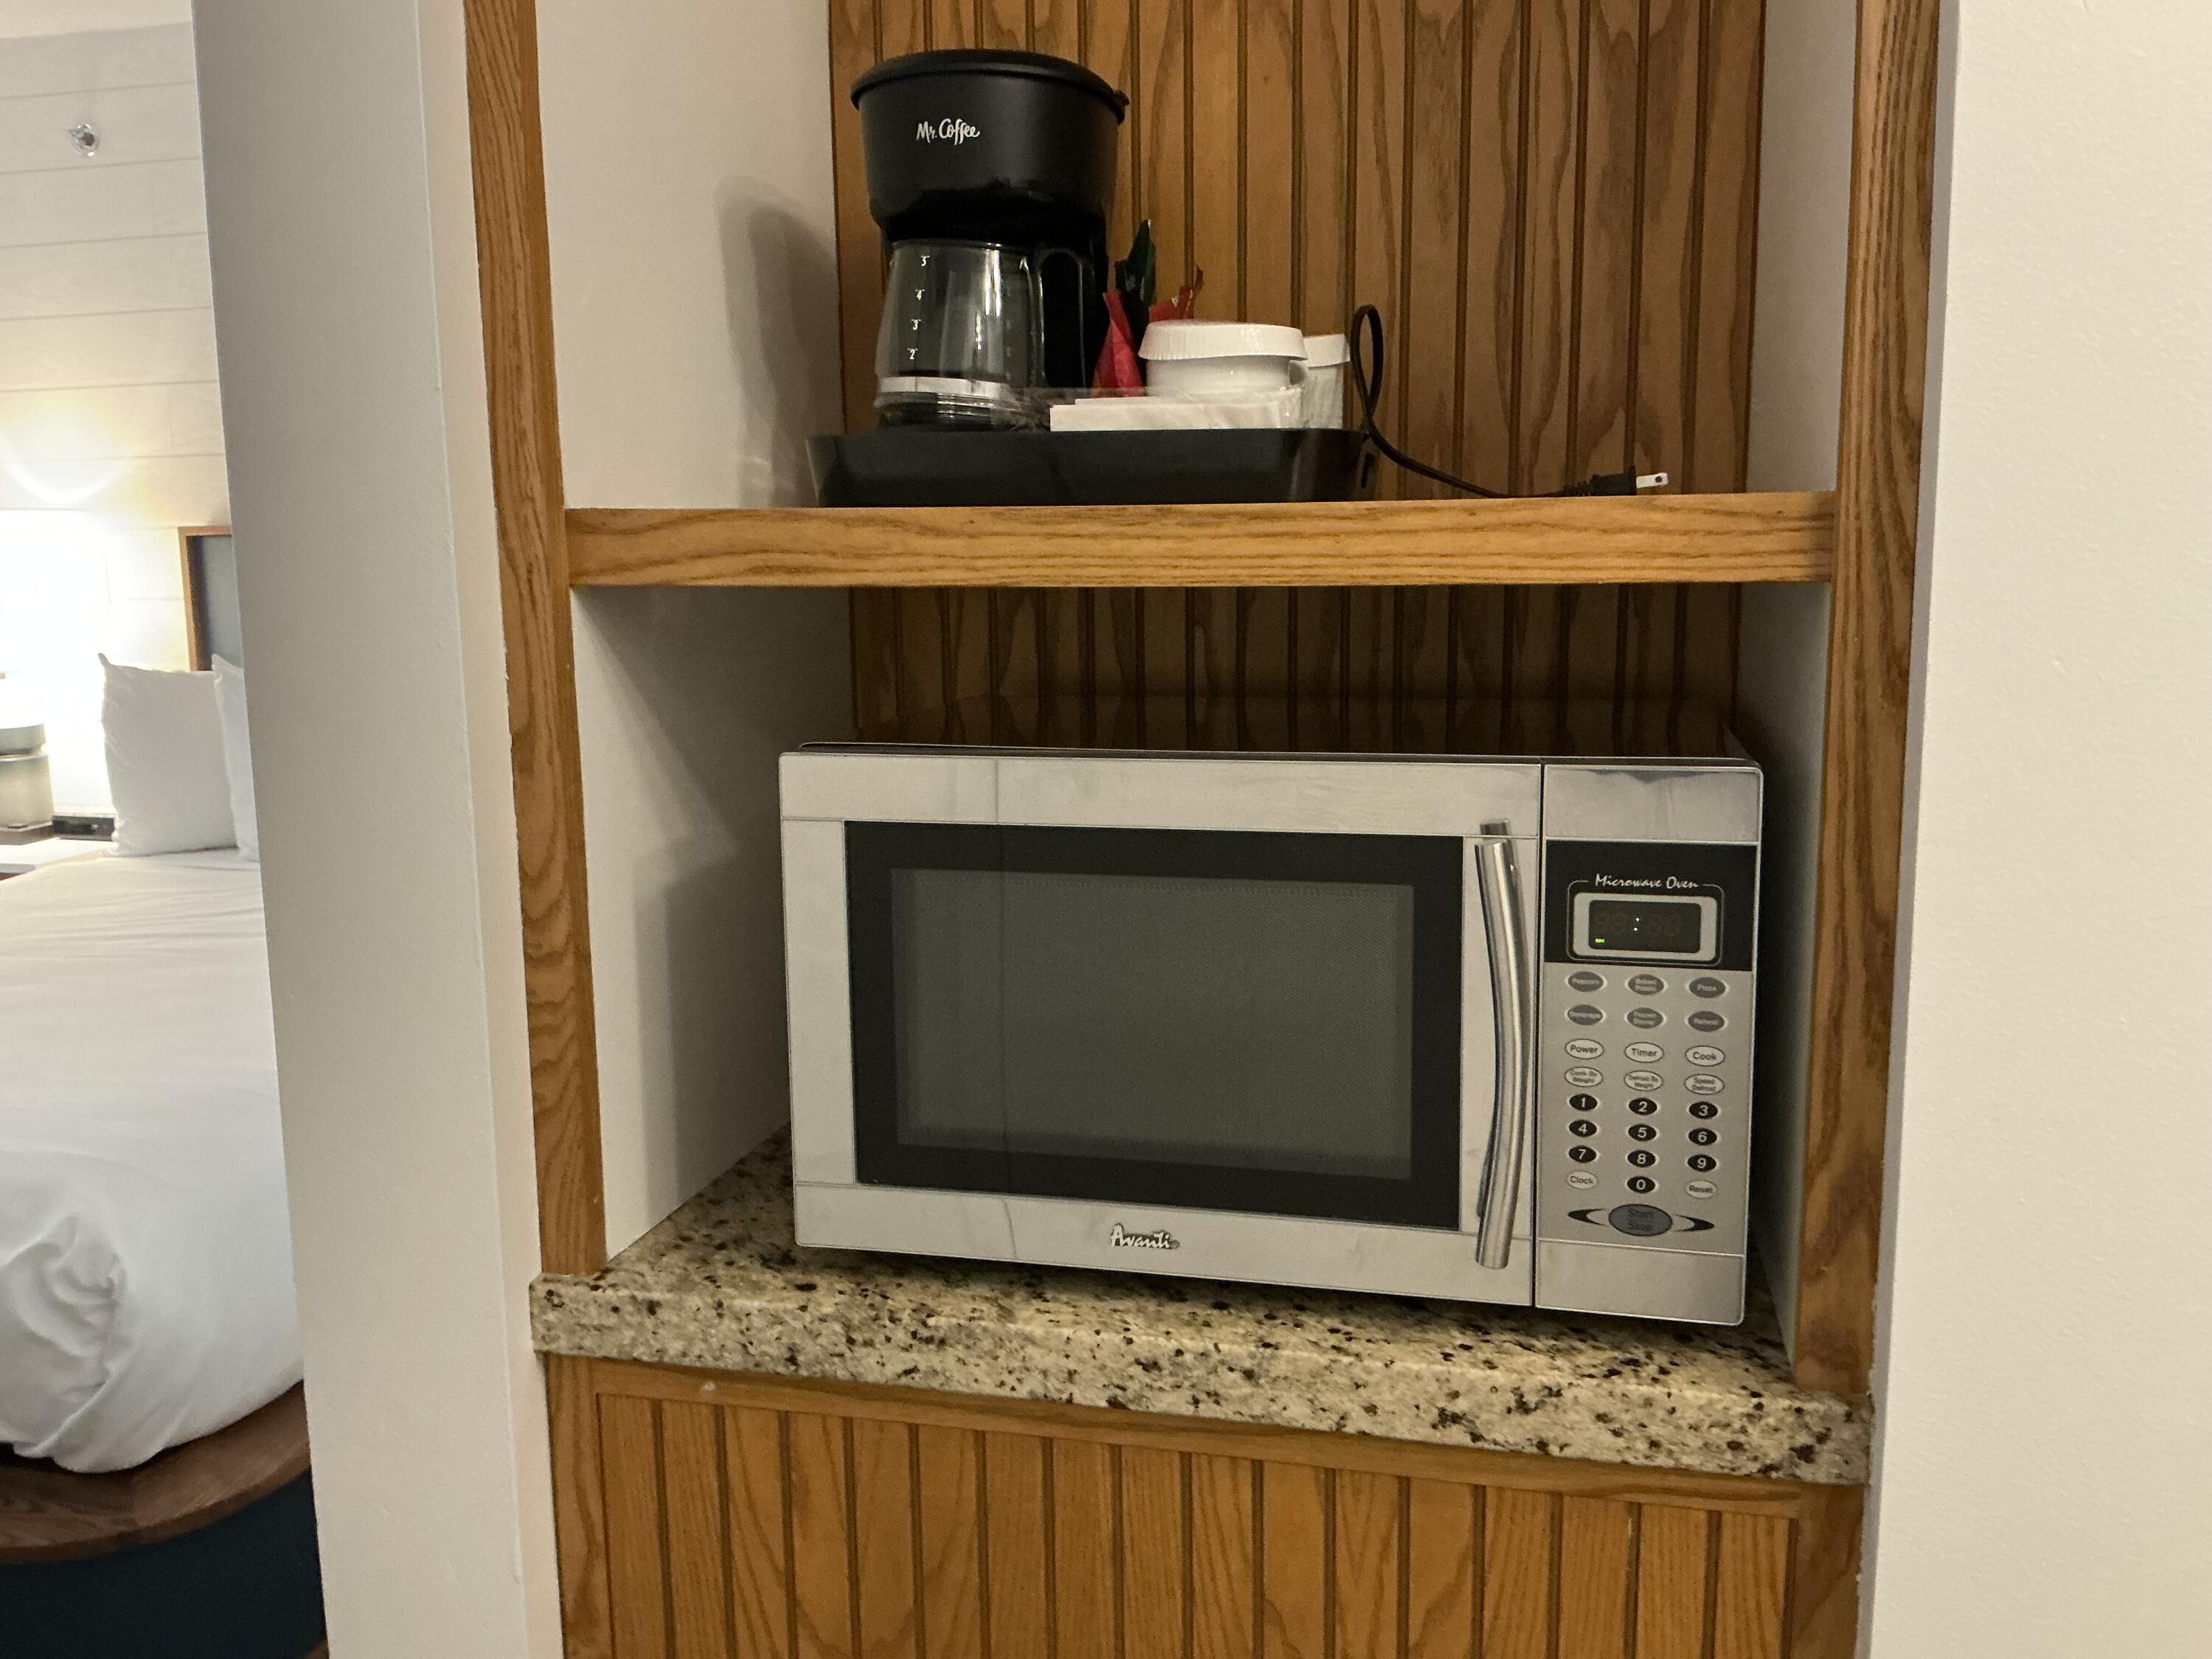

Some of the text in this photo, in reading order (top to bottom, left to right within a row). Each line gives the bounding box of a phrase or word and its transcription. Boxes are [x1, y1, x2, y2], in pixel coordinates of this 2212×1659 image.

[916, 118, 981, 146] Mr. Coffee
[1595, 873, 1699, 889] Microwave Oven
[1570, 1044, 1599, 1053] Power
[1631, 1048, 1658, 1057] Timer
[1693, 1051, 1717, 1060] Cook
[1580, 1097, 1587, 1108] 1
[1639, 1101, 1647, 1113] 2
[1699, 1105, 1708, 1116] 3
[1578, 1123, 1587, 1134] 4
[1637, 1127, 1646, 1138] 5
[1698, 1131, 1707, 1142] 6
[1578, 1149, 1586, 1160] 7
[1637, 1153, 1646, 1165] 8
[1697, 1157, 1706, 1169] 9
[1570, 1176, 1594, 1185] Clock
[1636, 1179, 1646, 1191] 0
[1689, 1185, 1714, 1194] Reset
[1627, 1208, 1654, 1219] Start
[1110, 1222, 1174, 1250] Avanti
